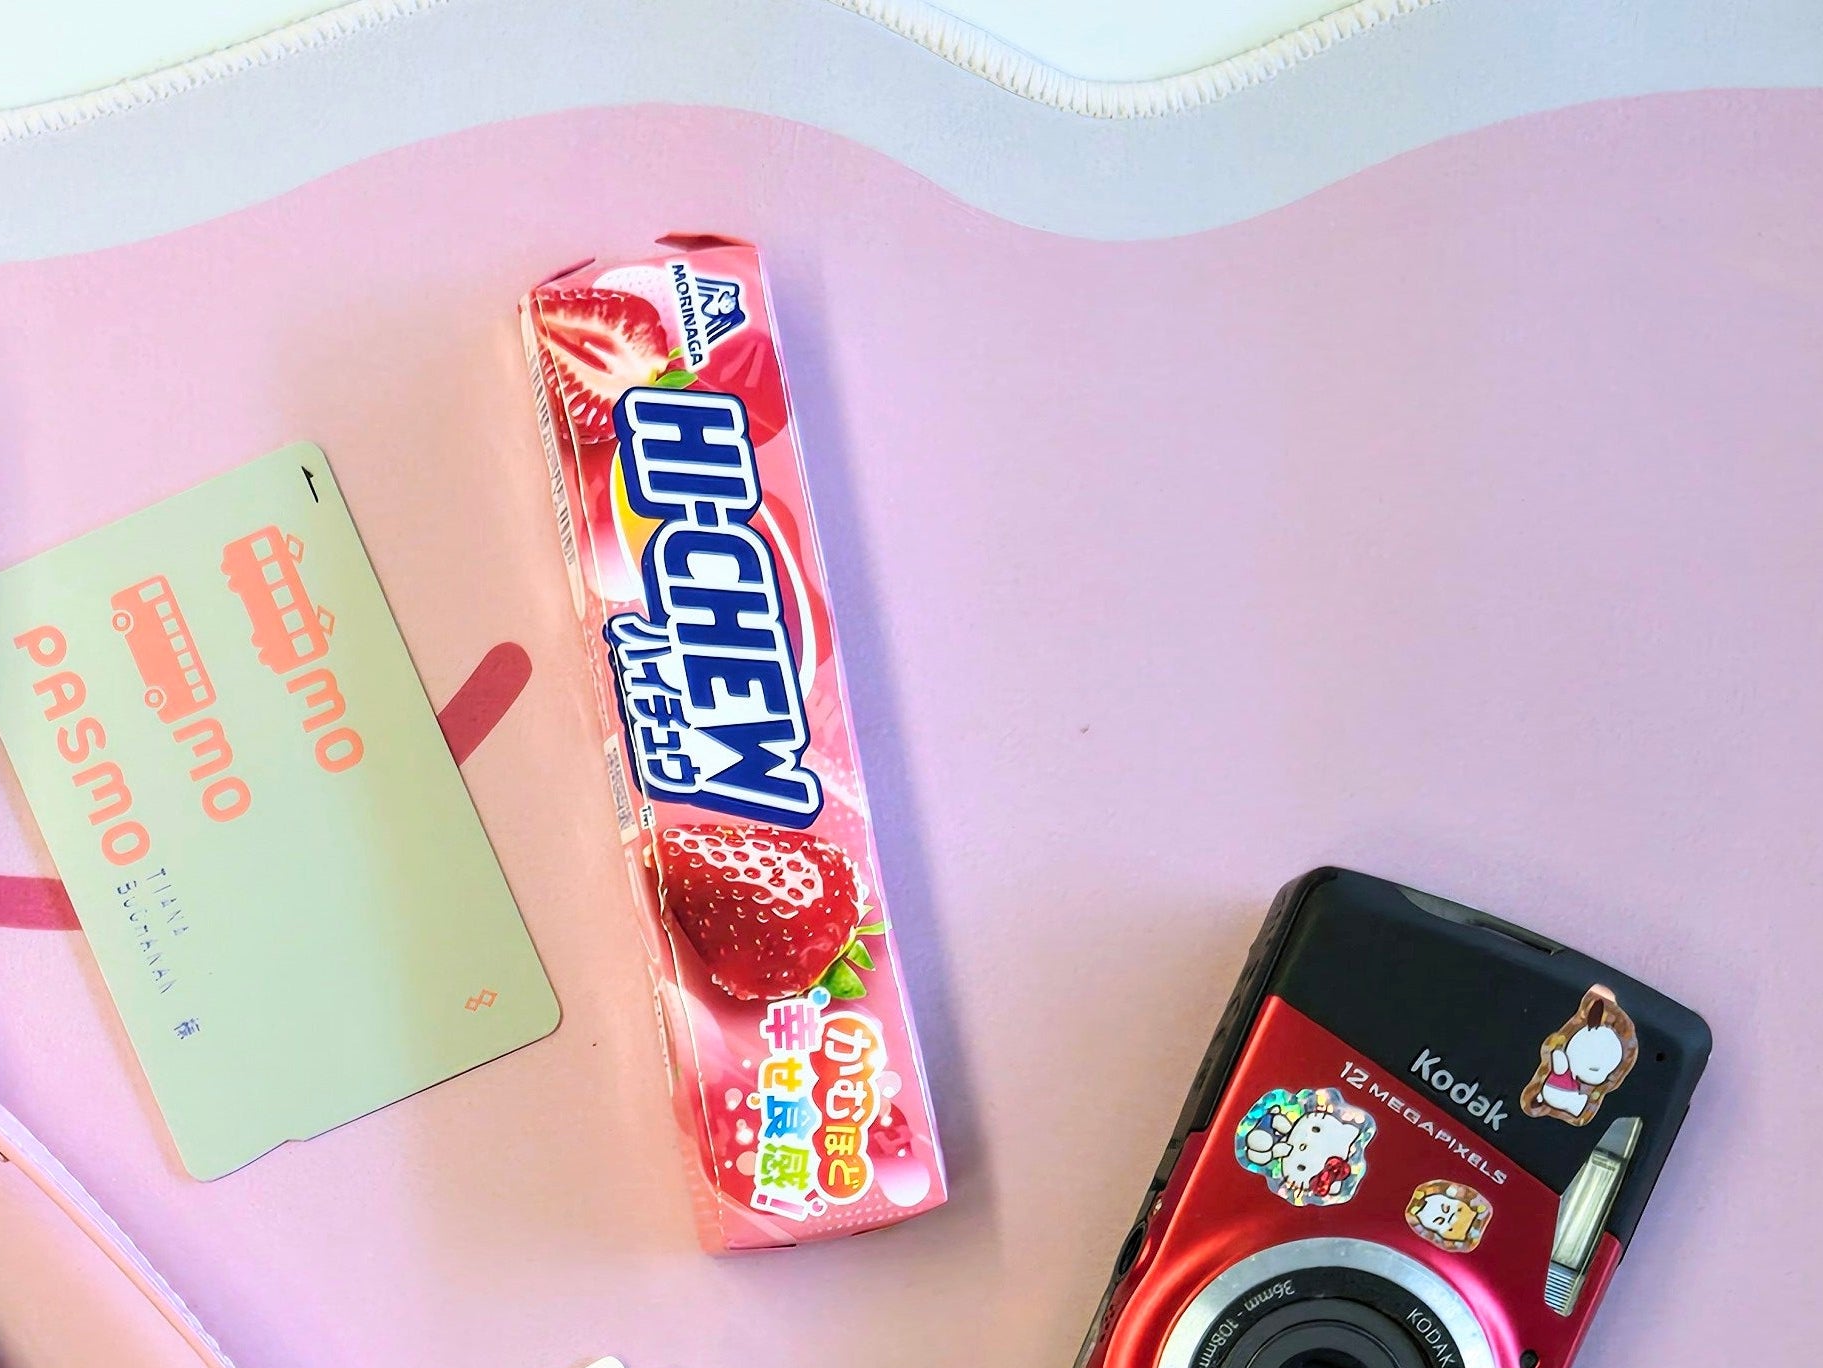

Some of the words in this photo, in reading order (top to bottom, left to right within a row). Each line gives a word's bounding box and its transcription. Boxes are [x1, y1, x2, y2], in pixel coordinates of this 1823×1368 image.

[670, 263, 704, 367] MORINAGA
[629, 396, 820, 822] HI-CHEW
[13, 625, 151, 867] PASMO
[617, 617, 705, 792] ハイチュウ
[825, 1027, 875, 1190] かむほど
[1340, 1061, 1370, 1090] 12
[1369, 1082, 1508, 1185] MEGAPIXELS
[1410, 1048, 1508, 1132] Kodak
[1244, 1279, 1296, 1313] 36mm
[1406, 1307, 1454, 1368] KODAK
